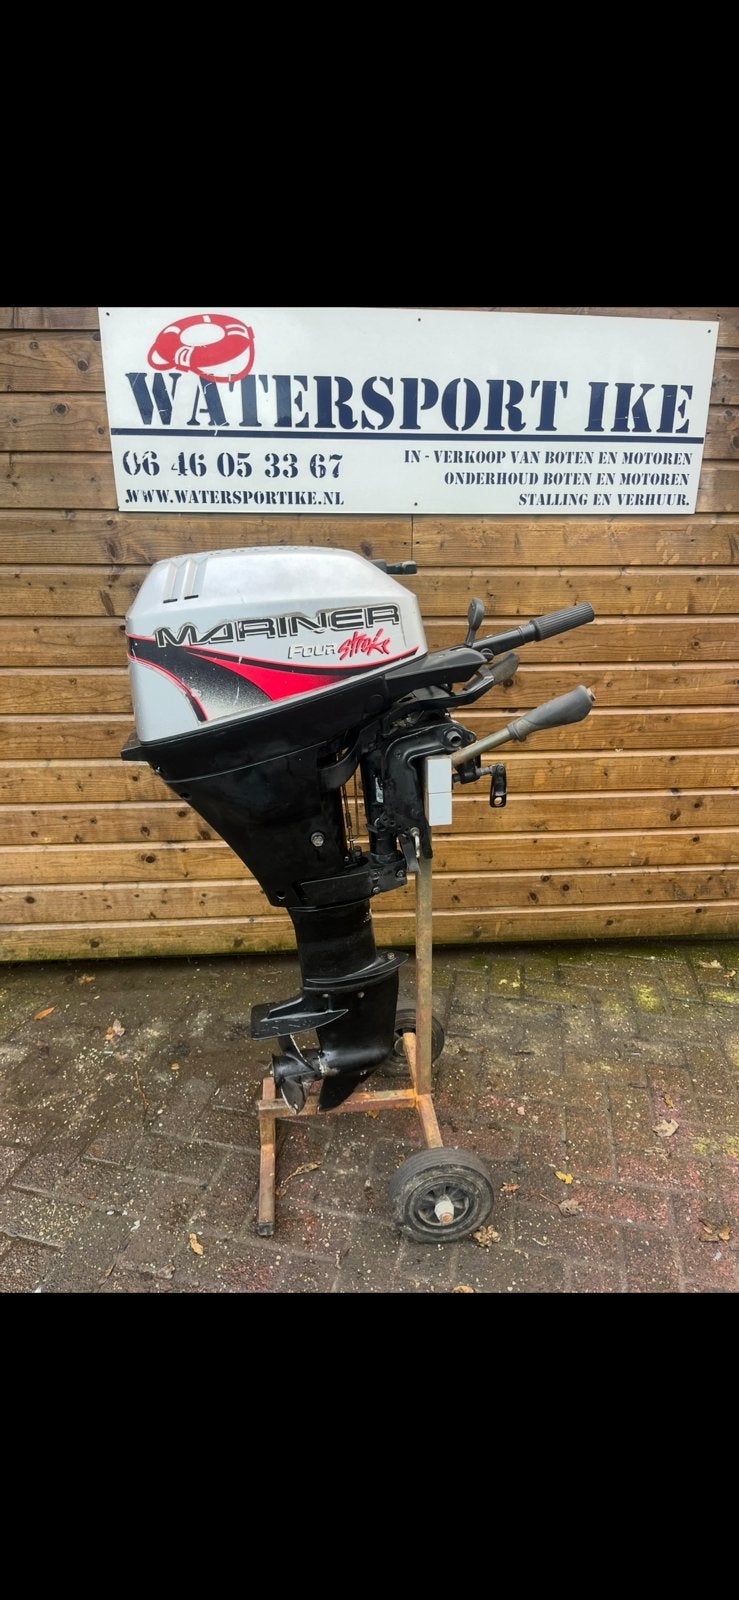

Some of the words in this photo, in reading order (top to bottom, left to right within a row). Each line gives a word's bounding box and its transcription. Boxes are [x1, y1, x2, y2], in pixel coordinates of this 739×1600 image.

[125, 372, 568, 431] WATERSPORT
[584, 381, 693, 434] IKE
[122, 450, 160, 476] 06
[171, 451, 207, 477] 46
[217, 452, 252, 478] 05
[264, 453, 298, 478] 33
[309, 453, 343, 479] 67
[404, 450, 421, 463] IN
[434, 450, 506, 464] VERKOOP
[511, 451, 540, 464] VAN
[545, 451, 594, 465] BOTEN
[598, 452, 617, 465] EN
[621, 452, 693, 465] MOTOREN
[444, 472, 539, 485] ONDERHOUD
[543, 472, 592, 486] BOTEN
[596, 473, 615, 486] EN
[619, 473, 690, 486] MOTOREN
[519, 493, 588, 506] STALLING
[593, 493, 612, 506] EN
[617, 493, 690, 506] VERHUUR.
[155, 604, 400, 647] MARINER
